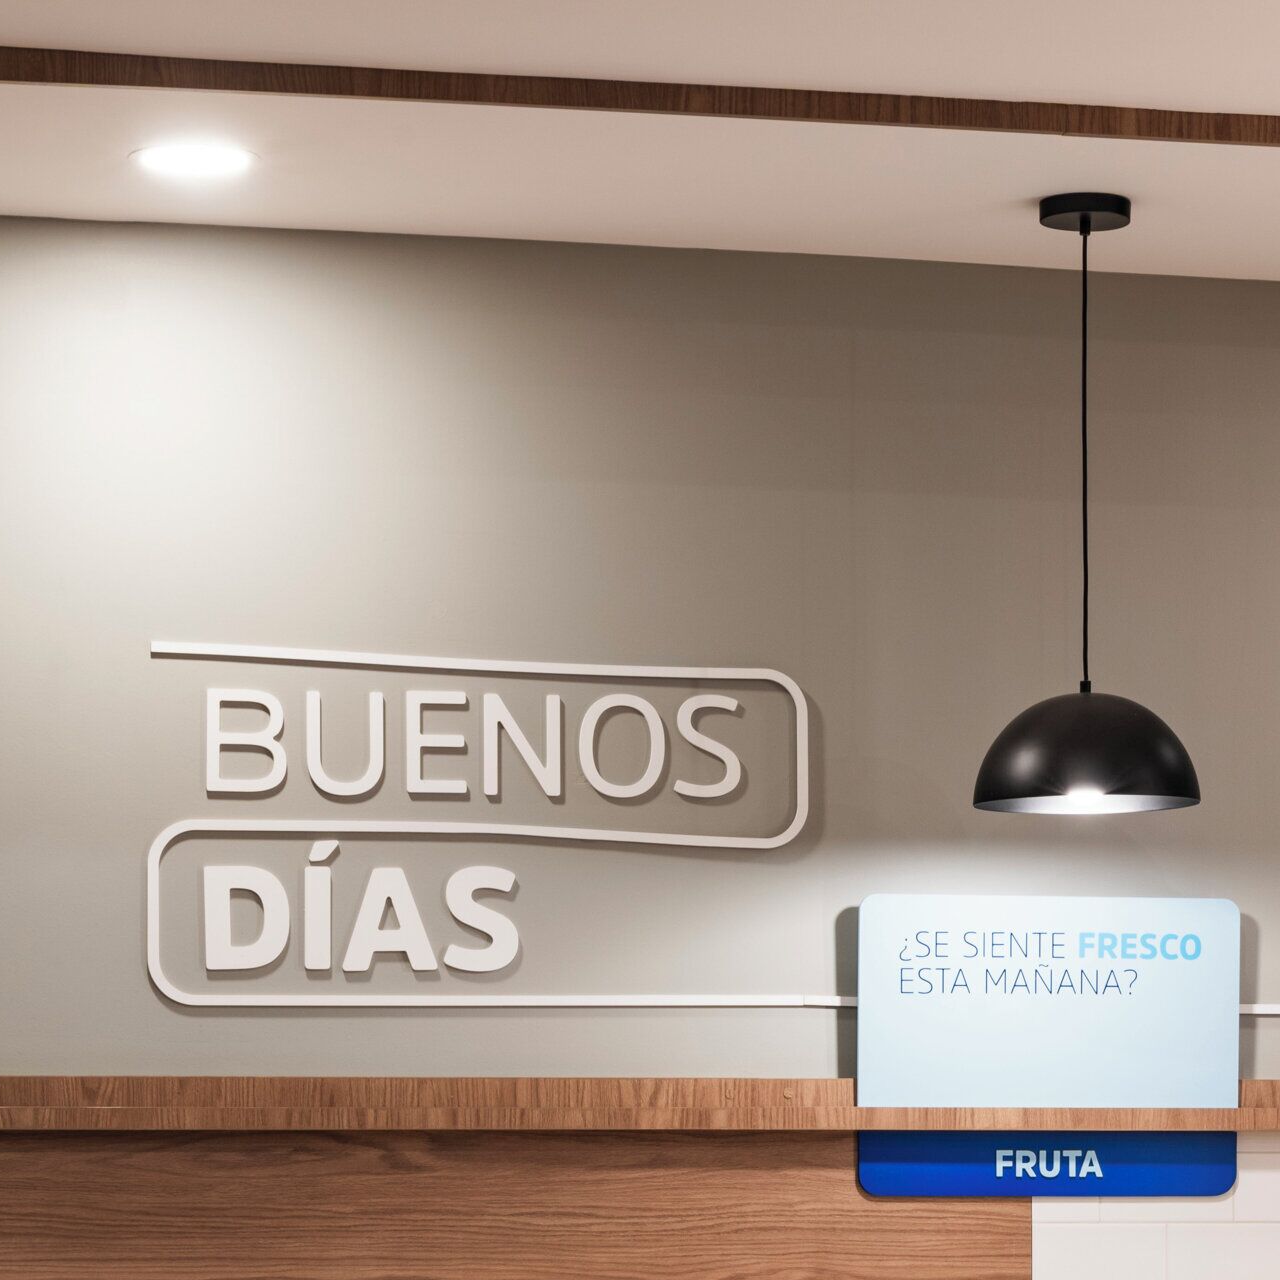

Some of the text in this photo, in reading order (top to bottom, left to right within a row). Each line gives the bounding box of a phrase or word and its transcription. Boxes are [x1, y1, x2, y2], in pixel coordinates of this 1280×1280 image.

[205, 687, 745, 798] BUENOS
[203, 840, 520, 972] DÍAS
[899, 931, 1202, 962] ¿SE SIENTE FRESCO
[900, 963, 1139, 996] ESTA MAÑANA?
[995, 1149, 1104, 1179] FRUTA
